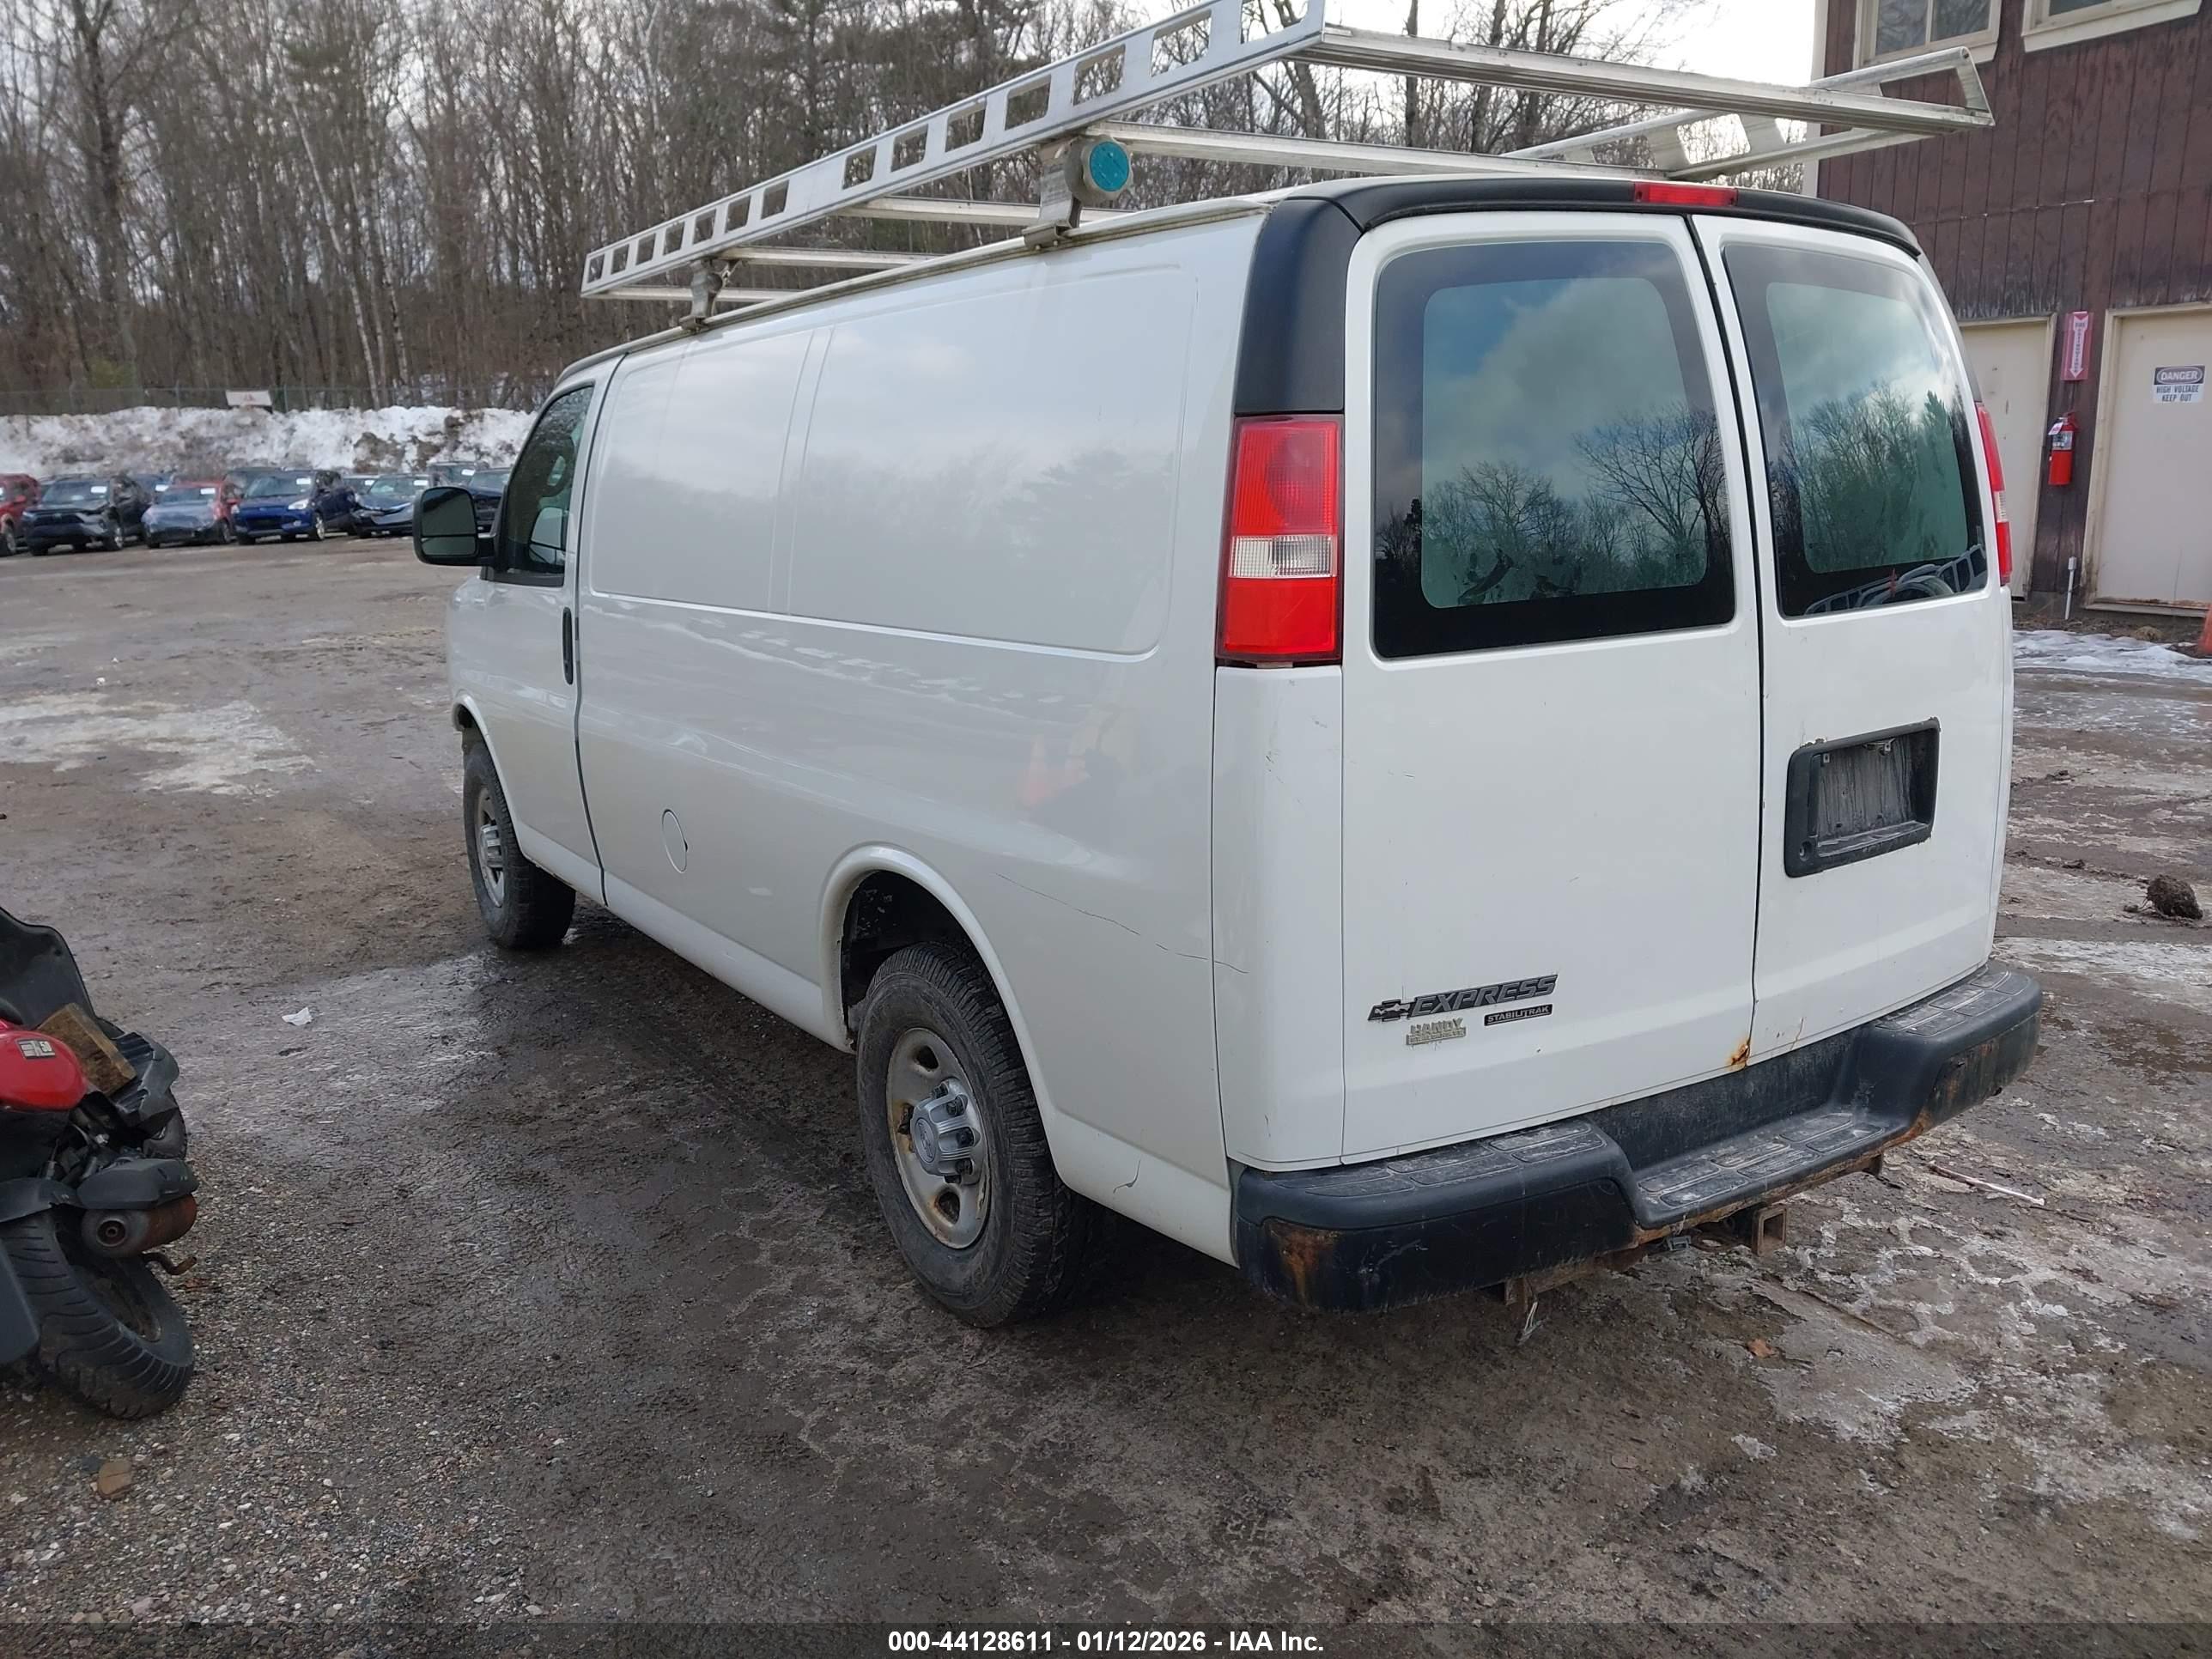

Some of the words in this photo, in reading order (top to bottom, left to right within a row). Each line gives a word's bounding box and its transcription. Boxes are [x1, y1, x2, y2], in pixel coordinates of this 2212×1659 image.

[2160, 370, 2198, 380] DANGER
[2174, 385, 2199, 393] VOLTAGE
[2180, 393, 2192, 402] OUT
[1411, 975, 1558, 1017] EXPRESS
[1486, 1006, 1550, 1023] STABILITRAK
